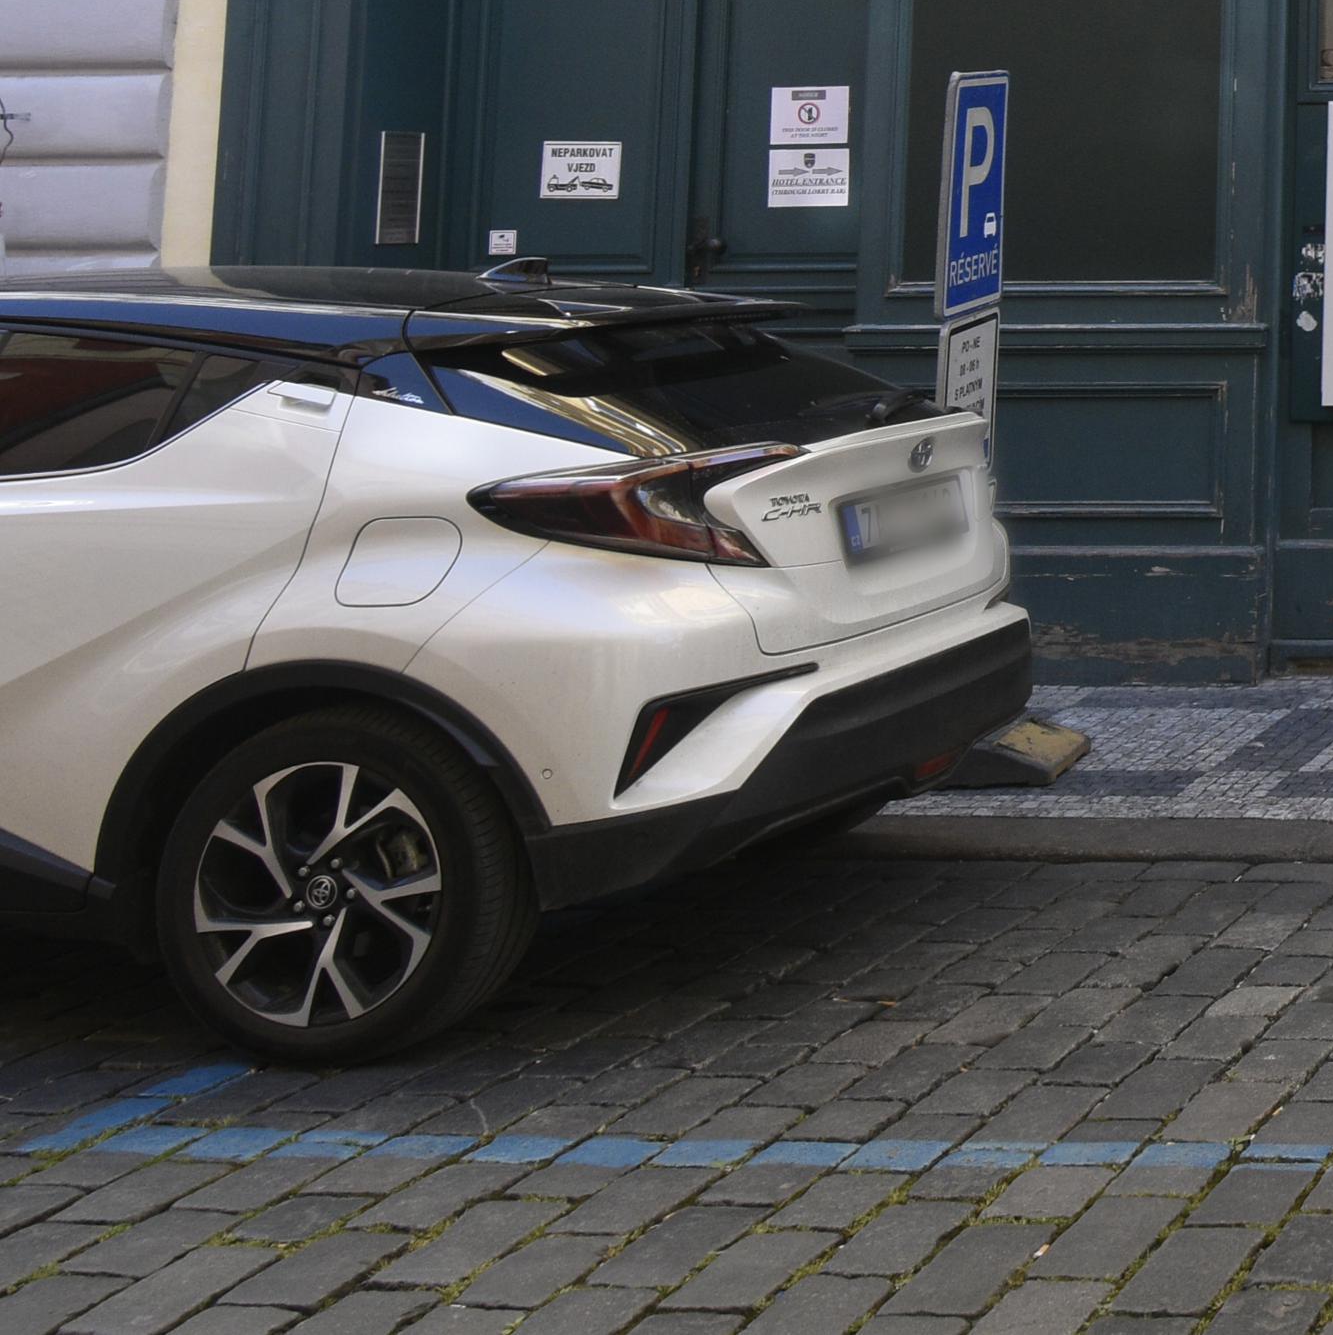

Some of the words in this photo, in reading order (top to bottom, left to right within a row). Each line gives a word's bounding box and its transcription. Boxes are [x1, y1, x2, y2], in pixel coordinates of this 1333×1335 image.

[551, 148, 614, 158] NEPARKOVAT
[567, 163, 596, 172] VJEZD
[959, 106, 995, 238] P
[772, 178, 799, 186] HOTEL
[802, 177, 847, 186] ENTRANCE
[950, 246, 999, 287] RÉSERVÉ
[769, 493, 810, 507] TOYOTA
[761, 502, 822, 522] C-HR
